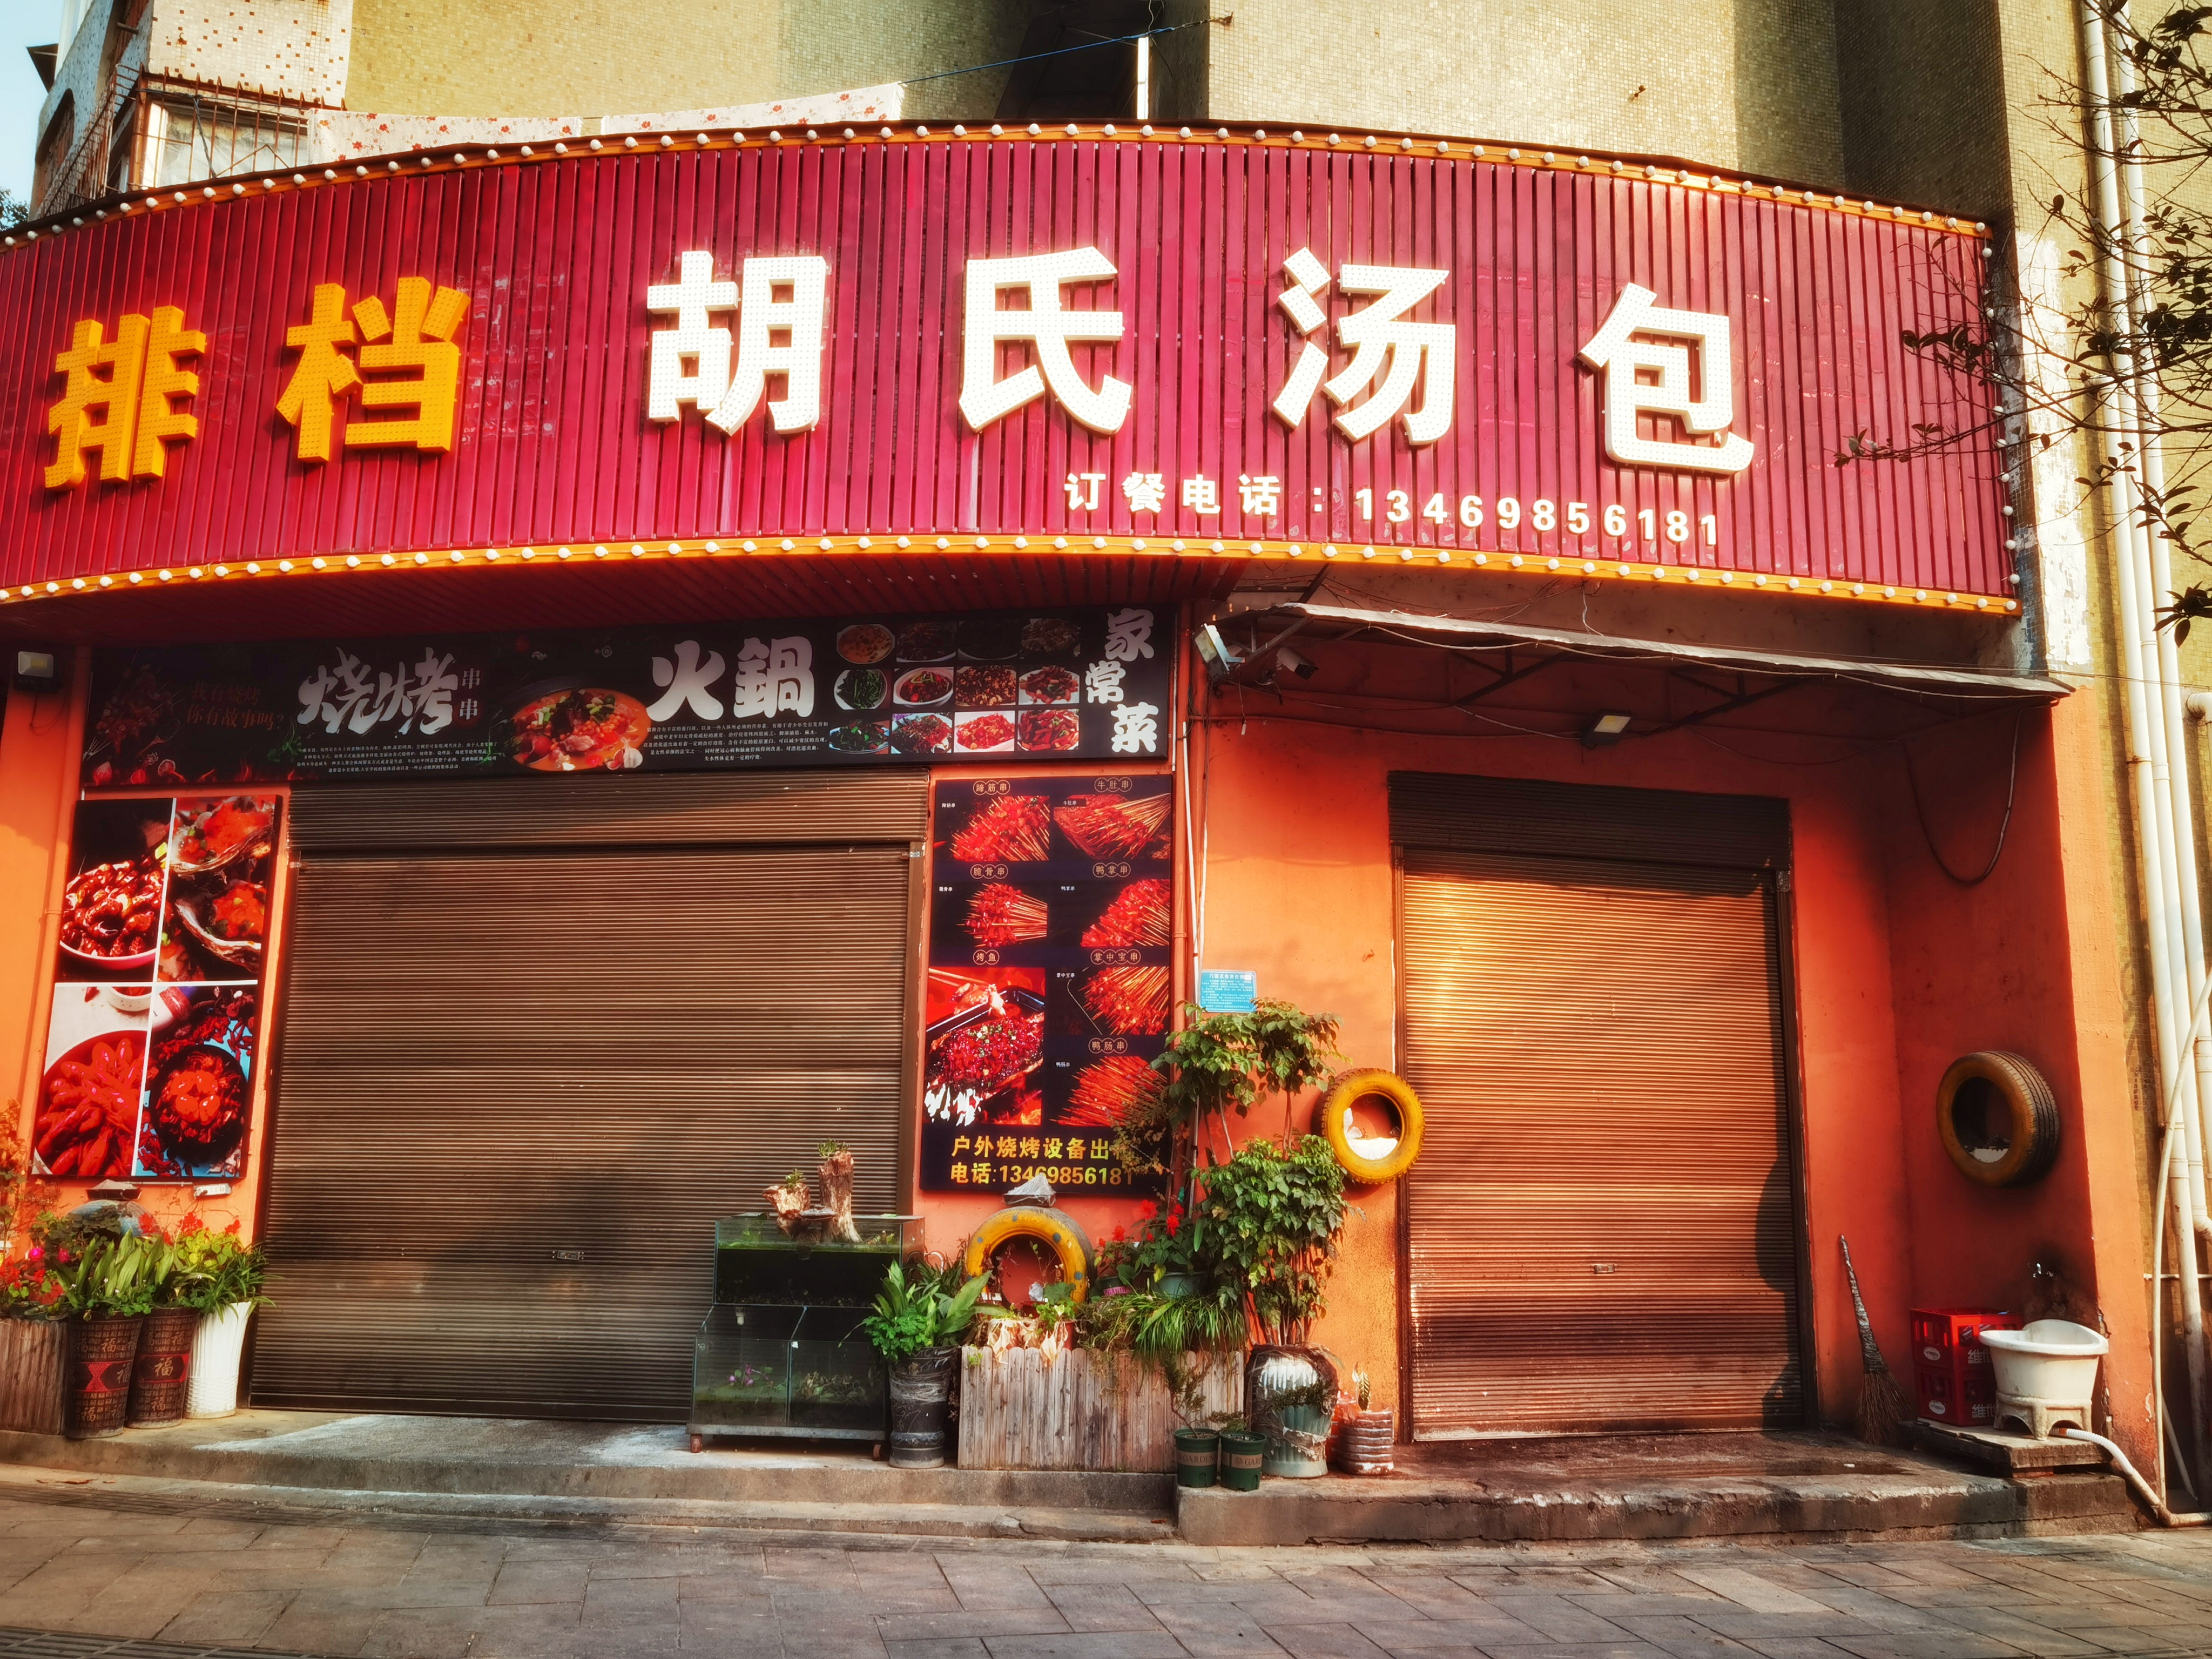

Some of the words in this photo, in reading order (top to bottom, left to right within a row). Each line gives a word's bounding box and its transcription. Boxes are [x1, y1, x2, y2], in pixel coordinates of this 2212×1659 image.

[647, 246, 1754, 474] 胡氏汤包
[44, 276, 471, 491] 排档
[646, 636, 815, 722] 火鍋
[1085, 608, 1158, 753] 家常菜
[298, 647, 458, 739] 烧烤
[458, 667, 481, 721] 串串
[976, 782, 1008, 793] 蹄筋串
[1097, 779, 1129, 790] 牛肚串
[973, 866, 1005, 876] 脆骨串
[1096, 865, 1128, 874] 鸭掌串
[976, 953, 996, 962] 烤鱼
[1094, 952, 1138, 962] 掌中宝串
[1091, 1041, 1125, 1050] 鸭肠串
[952, 1135, 1121, 1161] 户外烧烤设备出
[155, 1357, 173, 1377] 福
[1183, 1455, 1214, 1463] GARDEN
